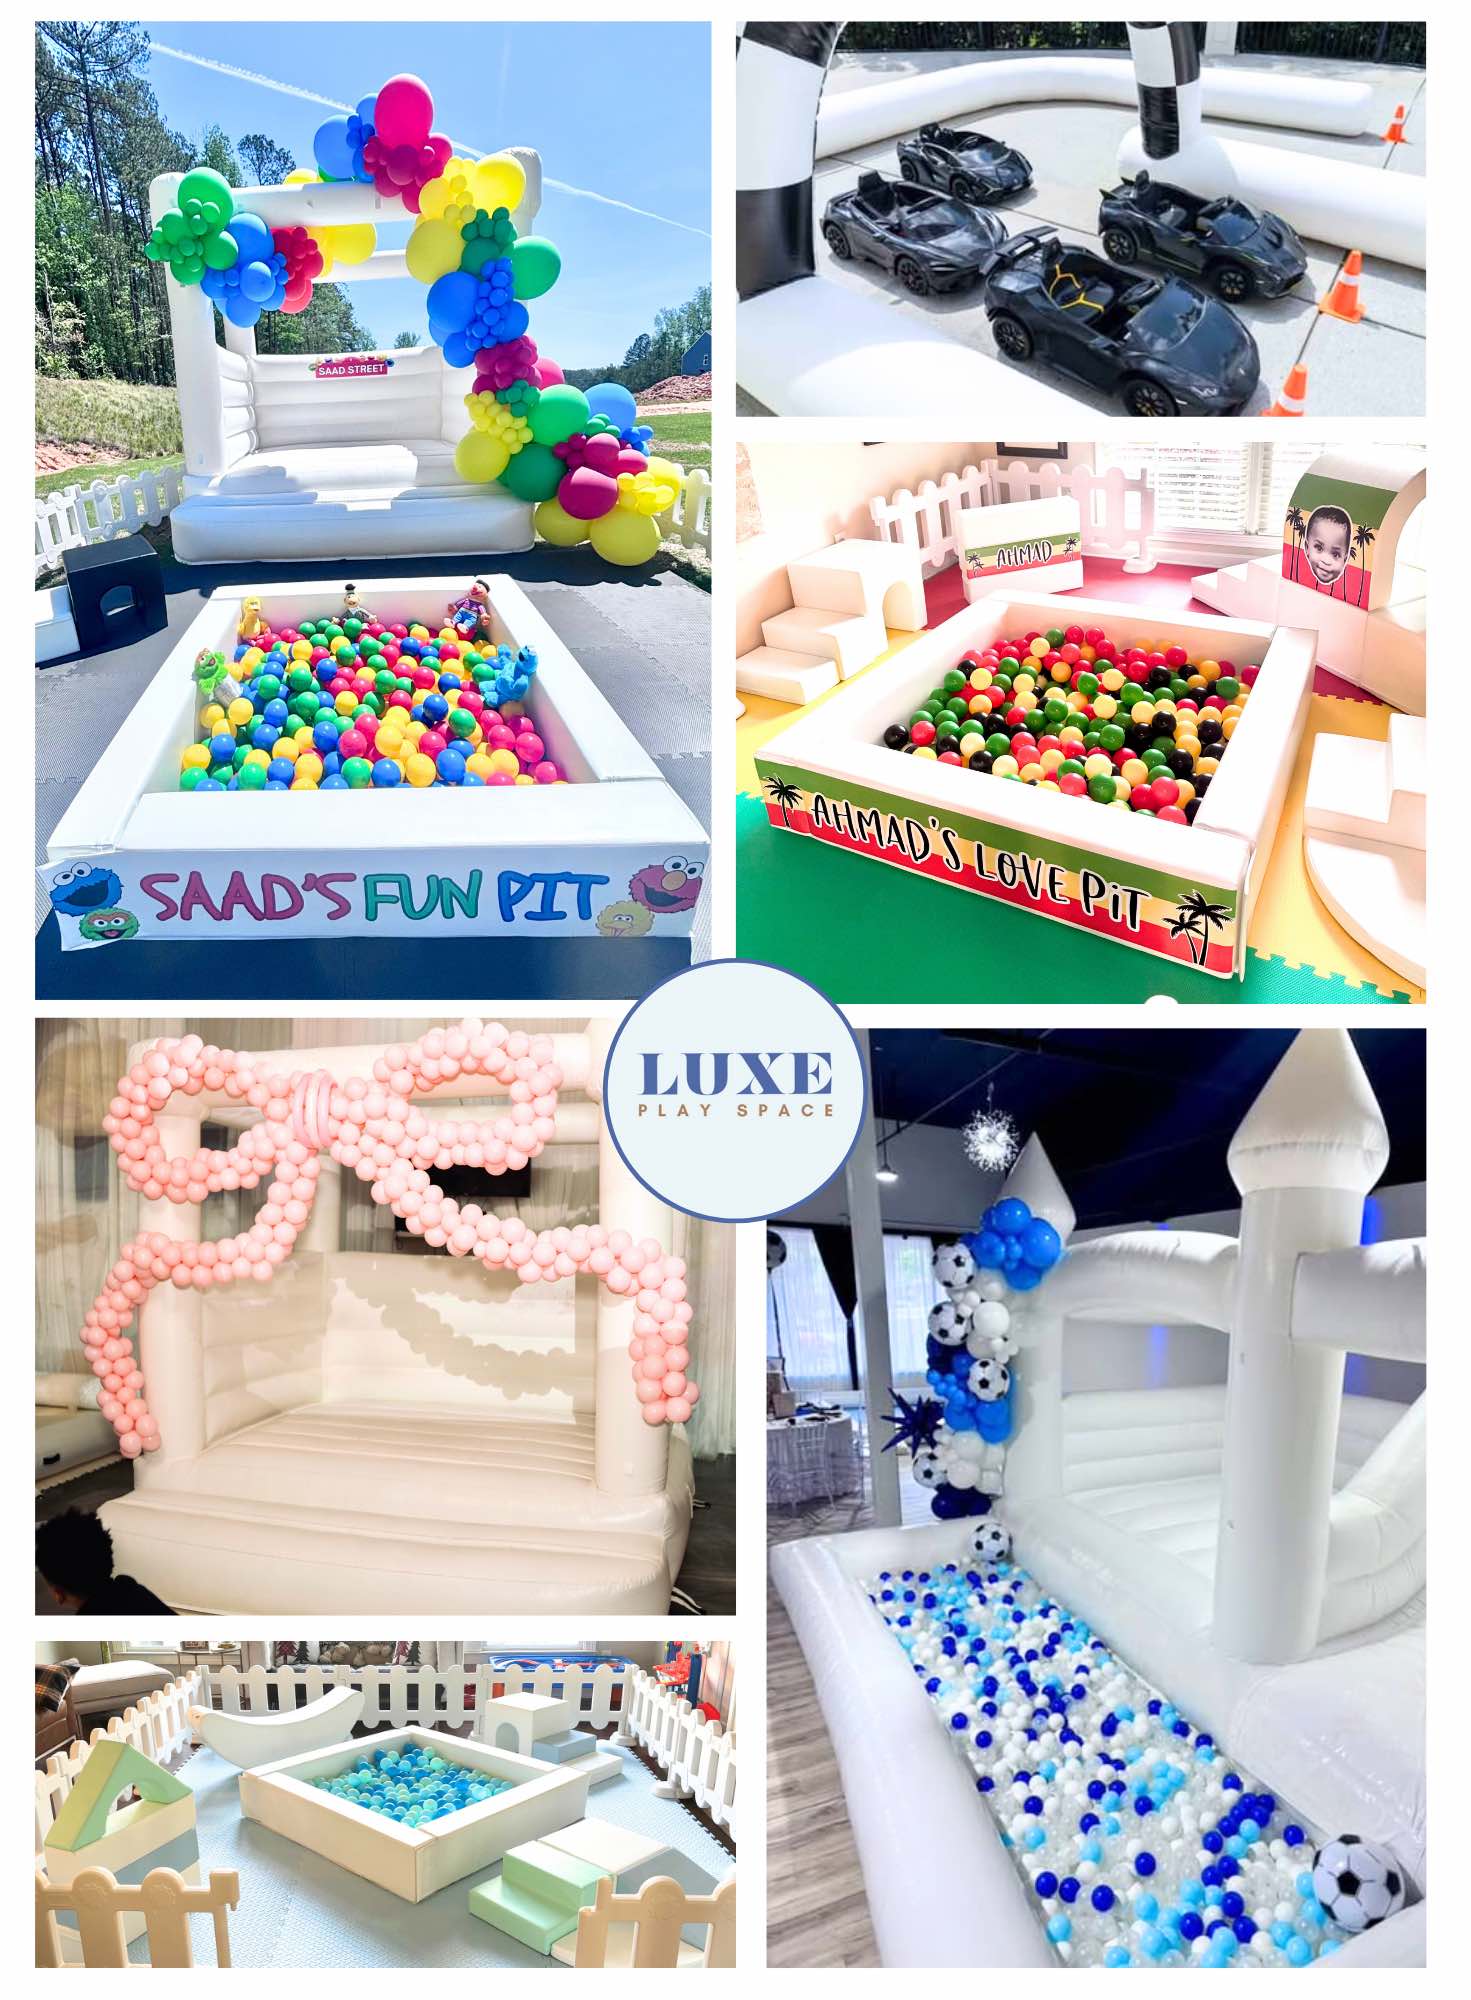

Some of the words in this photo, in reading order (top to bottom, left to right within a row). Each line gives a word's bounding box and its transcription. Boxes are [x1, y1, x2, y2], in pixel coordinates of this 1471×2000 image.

[318, 366, 346, 376] SAAD
[347, 364, 385, 374] STREET
[996, 540, 1053, 569] AHMAD
[811, 793, 963, 871] AHMAD'S
[975, 842, 1071, 904] LOVE
[139, 871, 357, 922] SAAD'S
[363, 868, 483, 922] FUN
[496, 870, 610, 922] PIT
